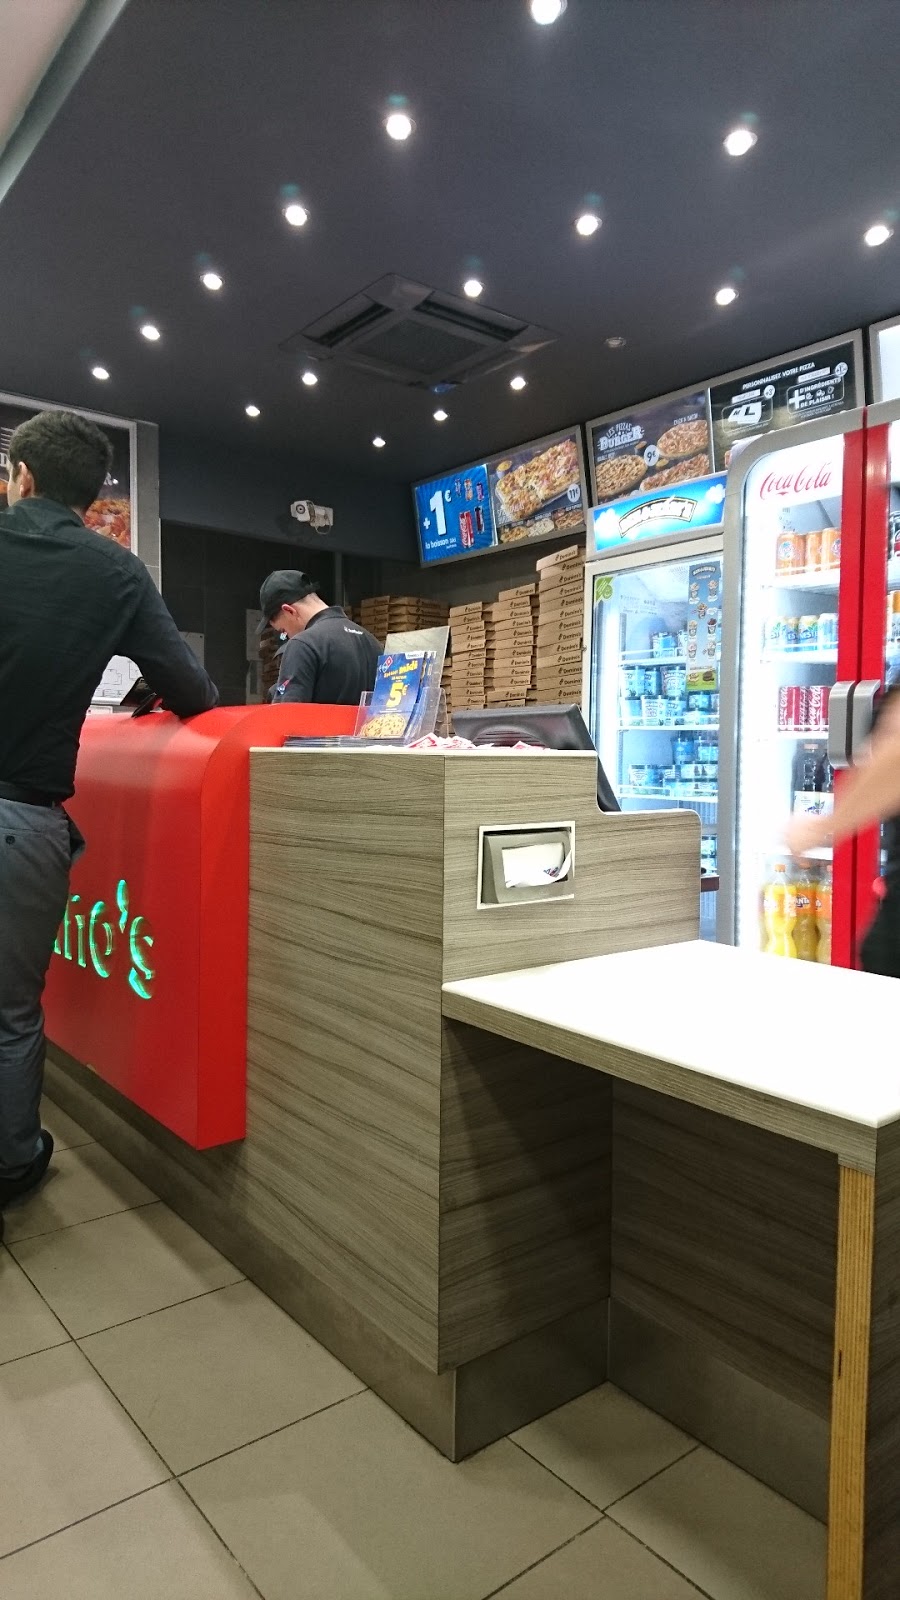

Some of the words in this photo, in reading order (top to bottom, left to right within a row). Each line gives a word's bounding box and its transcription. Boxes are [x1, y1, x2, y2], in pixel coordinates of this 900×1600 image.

[799, 362, 815, 372] PIZZA
[744, 406, 756, 416] L
[606, 427, 615, 438] LES
